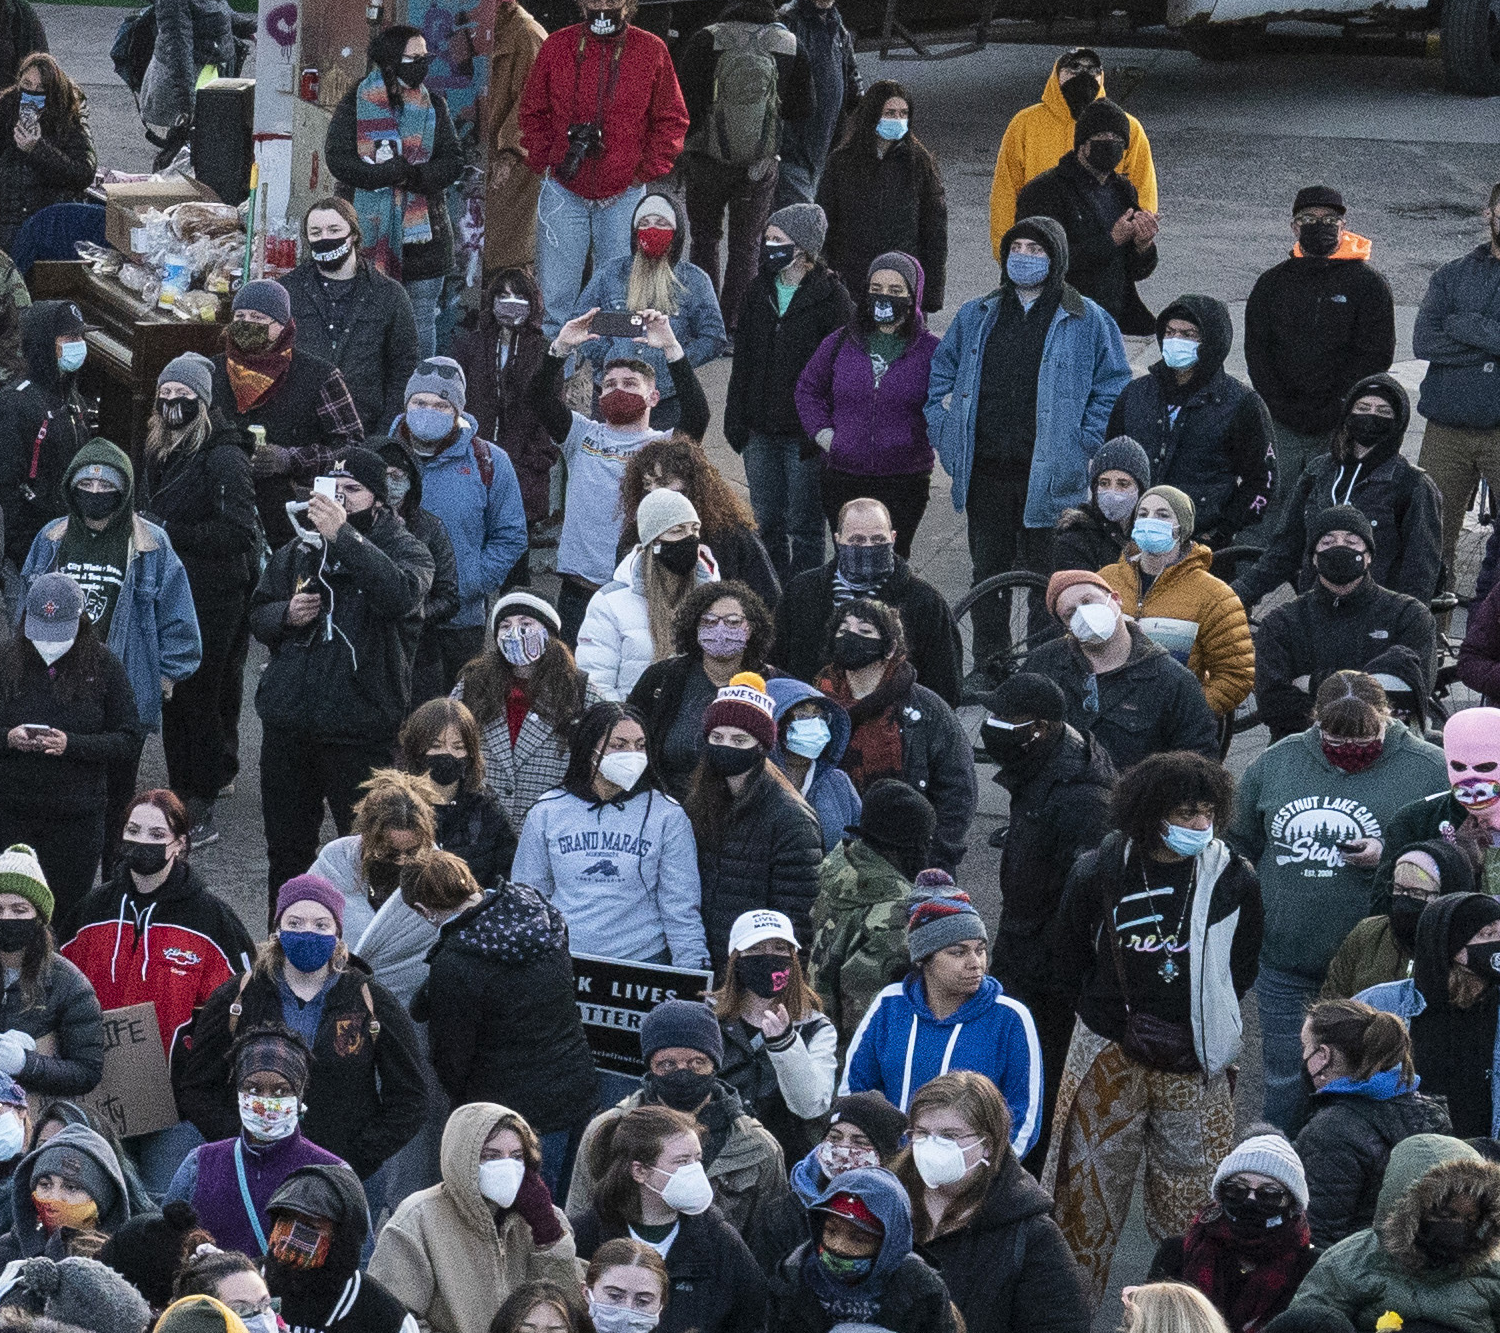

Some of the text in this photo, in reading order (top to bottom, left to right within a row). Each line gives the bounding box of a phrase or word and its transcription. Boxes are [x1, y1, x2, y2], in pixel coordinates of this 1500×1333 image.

[1271, 796, 1382, 840] CHESTNUT LAKE CAMP
[557, 831, 653, 859] GRAND MARAIS
[753, 922, 782, 930] MATTER
